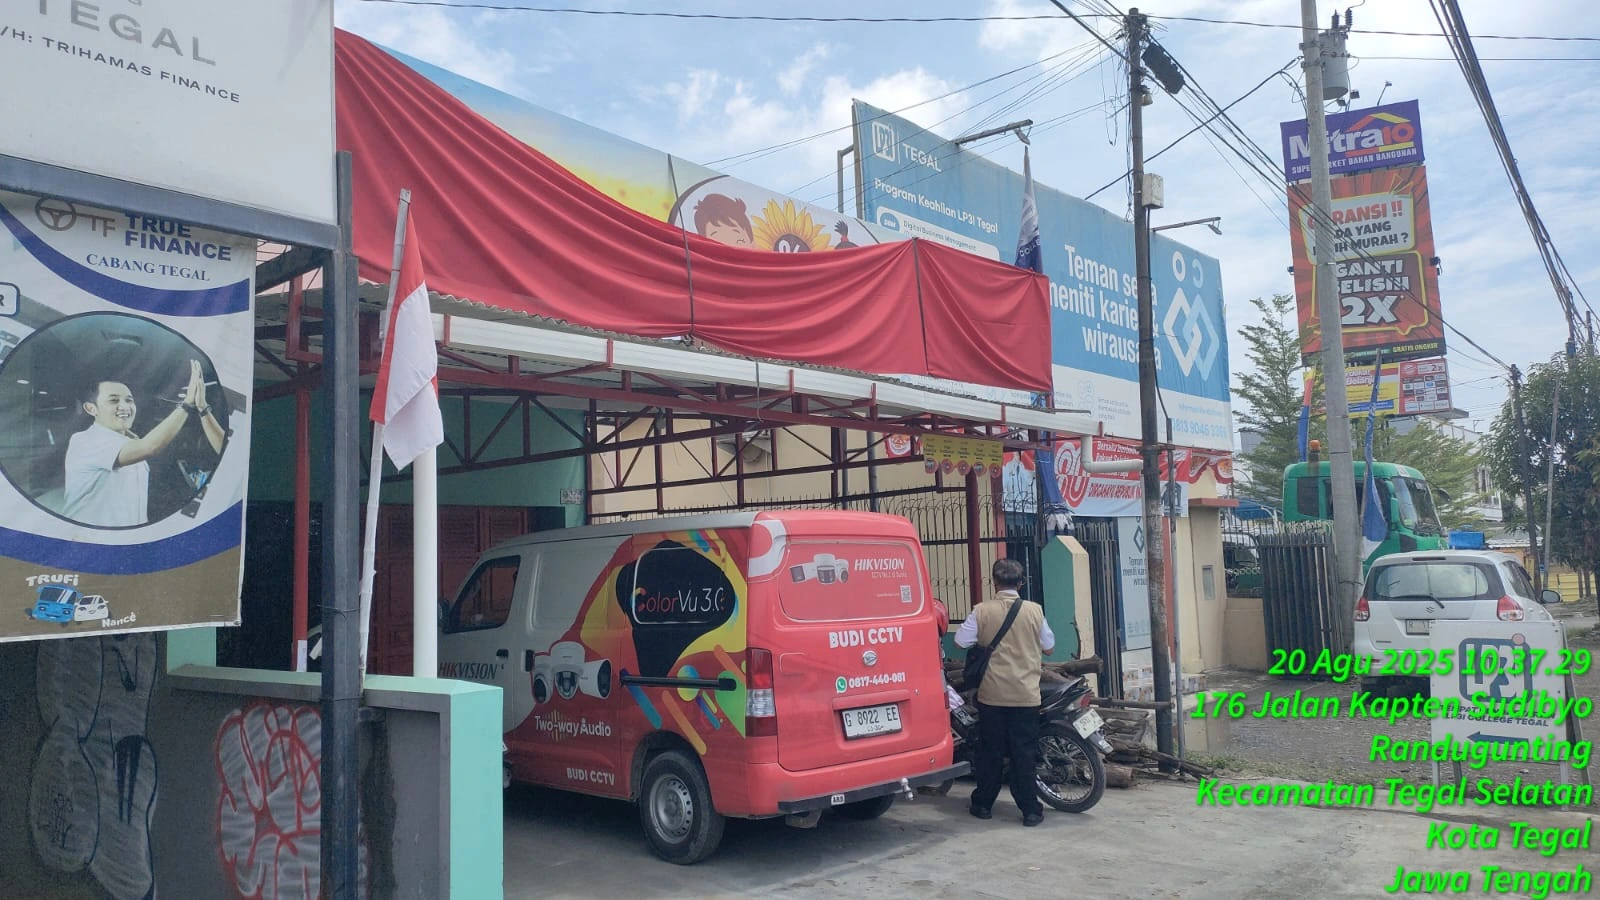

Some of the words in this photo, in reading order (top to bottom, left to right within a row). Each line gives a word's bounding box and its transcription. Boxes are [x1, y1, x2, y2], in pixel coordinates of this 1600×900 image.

[42, 37, 152, 76] TRIHAMAS
[160, 71, 240, 103] FINANCE
[902, 143, 942, 172] TEGAL
[1348, 154, 1373, 166] BAHAN
[1376, 147, 1416, 161] BANGUNAN
[874, 177, 917, 204] Program
[918, 194, 957, 219] Keahlian
[957, 209, 976, 226] LP3I
[976, 217, 998, 234] Tegal
[125, 211, 191, 238] TRUE
[1355, 221, 1392, 236] YANG
[125, 231, 231, 261] FINANCE
[1351, 233, 1398, 249] MURAH
[86, 253, 155, 274] CABANG
[159, 265, 210, 282] TEGAL
[1065, 244, 1119, 293] Teman
[1335, 260, 1403, 278] GANTI
[1341, 295, 1398, 325] 2X
[854, 558, 905, 571] HIKVISION
[829, 631, 864, 648] BUDI
[868, 627, 903, 645] CCTV
[438, 662, 497, 679] HIKVISION
[849, 672, 906, 688] 0817-440-081
[535, 715, 581, 737] Two-way
[580, 718, 612, 737] Audio
[845, 713, 853, 727] G
[857, 709, 880, 726] 8922
[886, 706, 898, 721] EE
[1516, 717, 1549, 727] TEGAL
[567, 768, 589, 782] BUDI
[590, 771, 615, 786] CCTV
